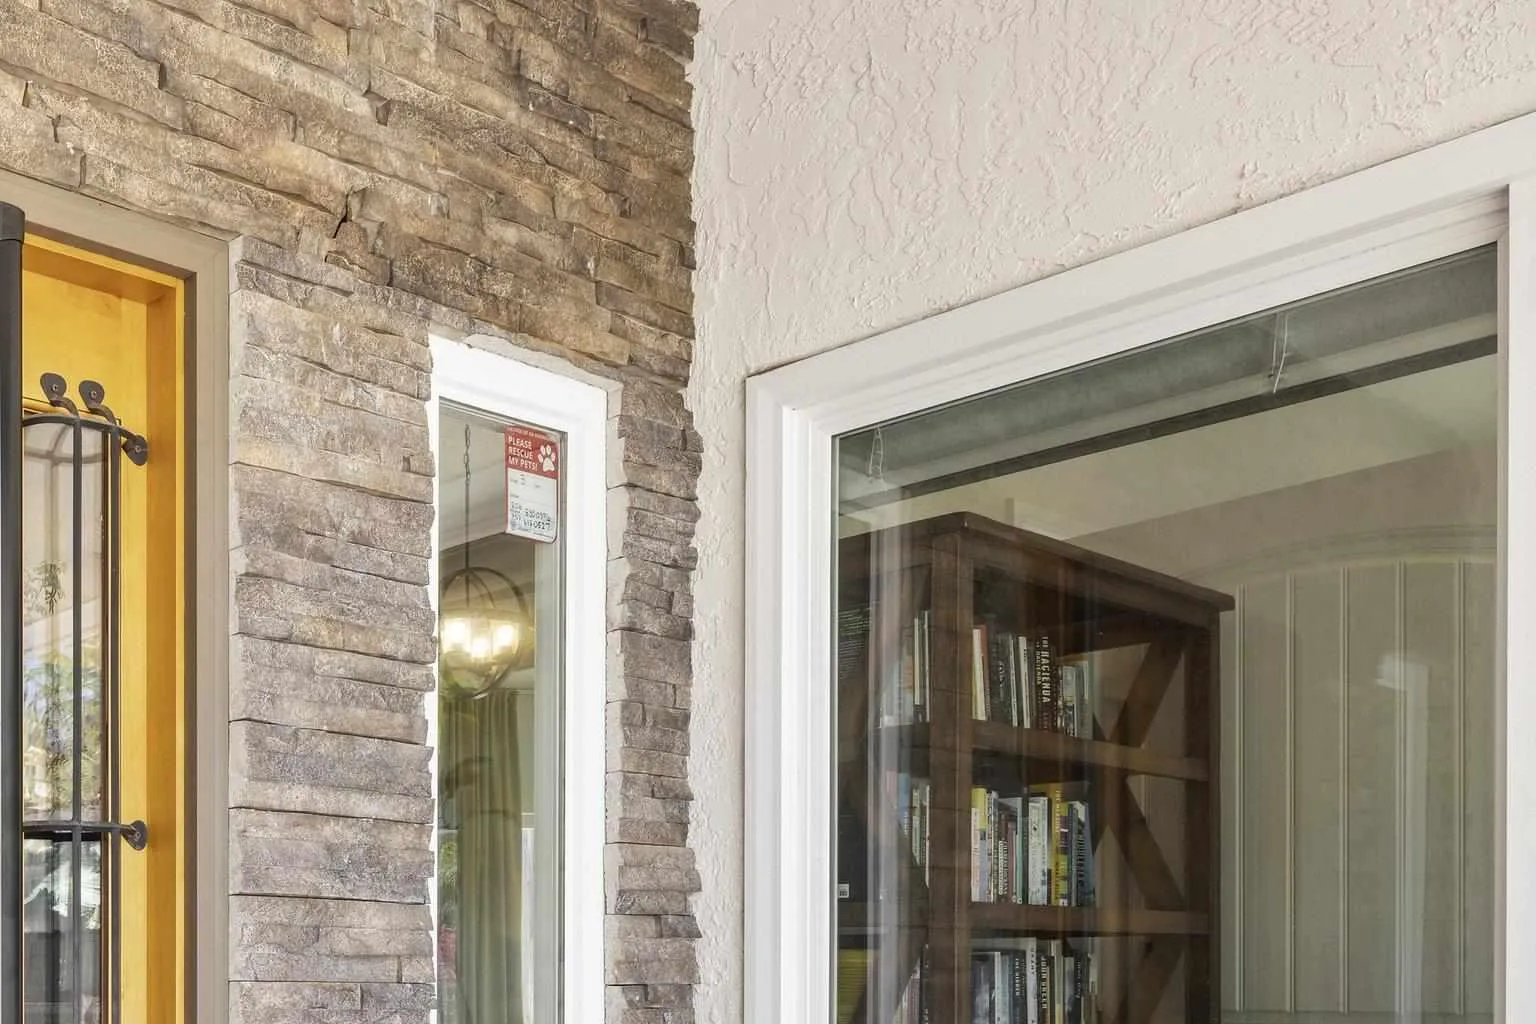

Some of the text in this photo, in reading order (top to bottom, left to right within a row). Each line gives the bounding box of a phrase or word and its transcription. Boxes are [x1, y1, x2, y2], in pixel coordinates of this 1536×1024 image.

[508, 436, 532, 450] PLEASE
[508, 446, 534, 459] RESCUE
[508, 456, 519, 465] MY
[1040, 651, 1051, 703] HACIENDA
